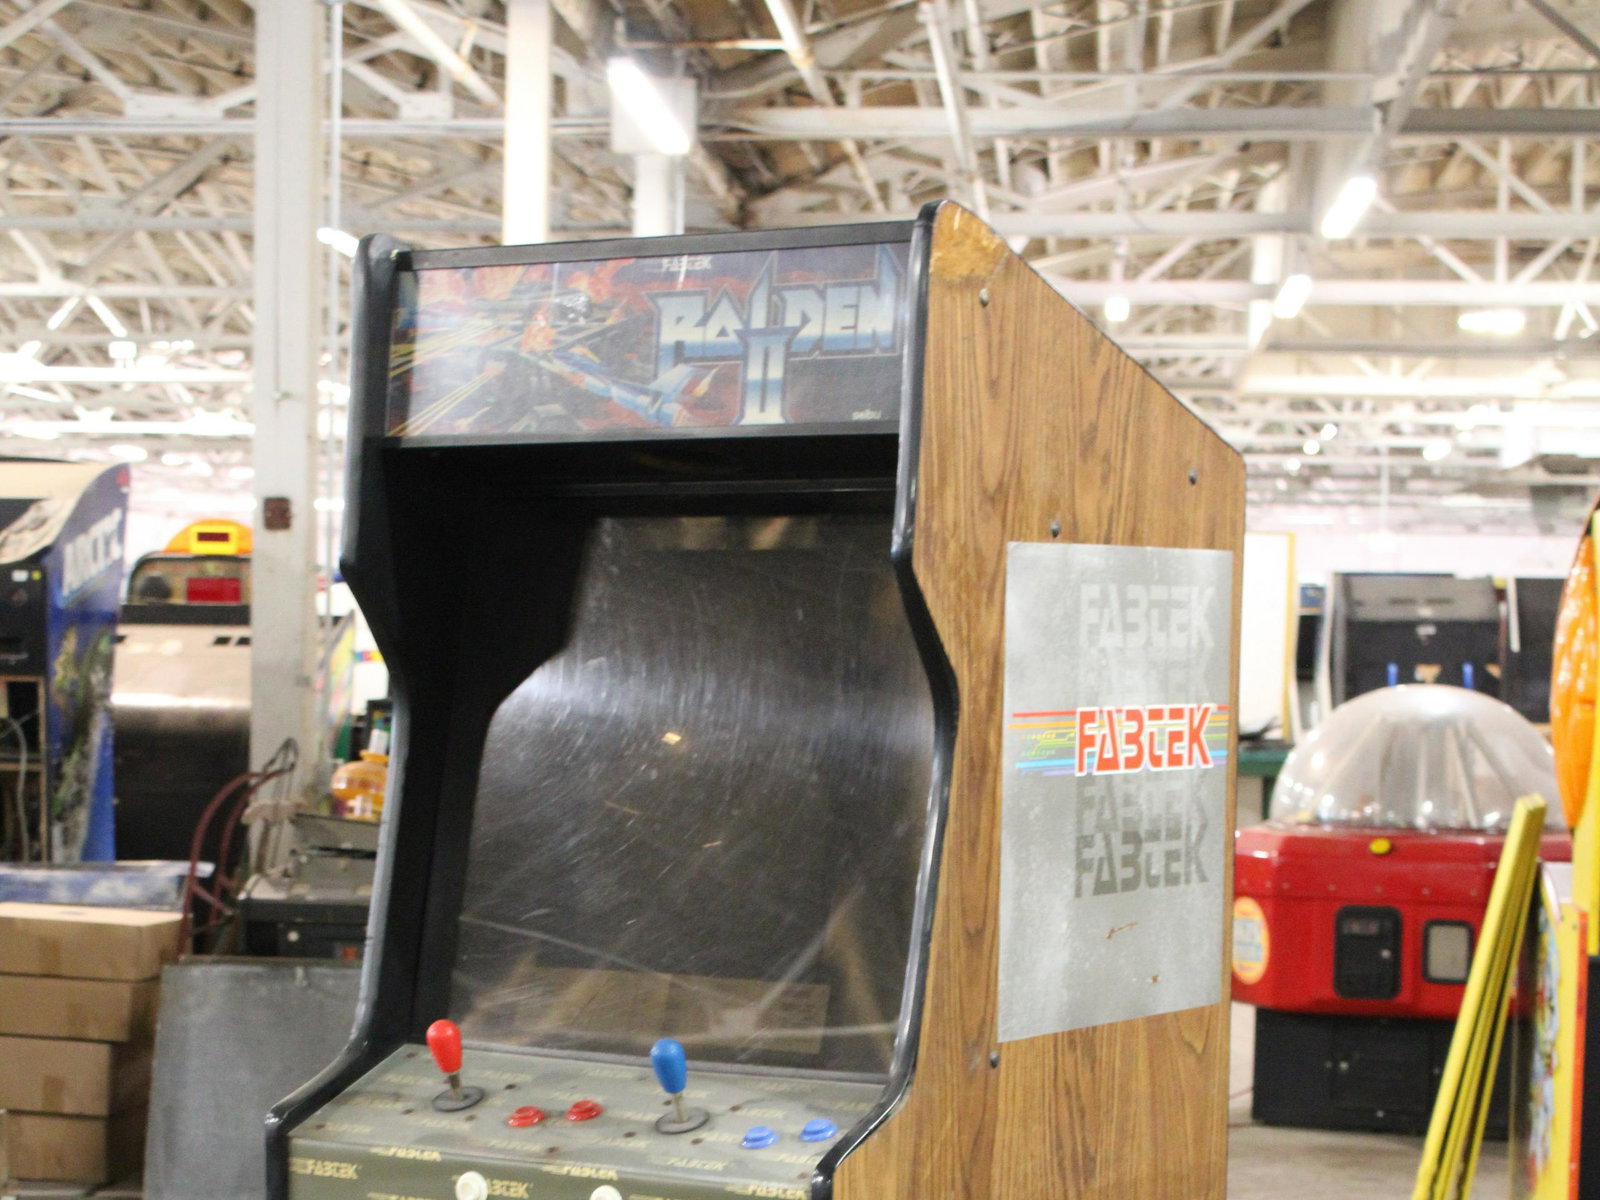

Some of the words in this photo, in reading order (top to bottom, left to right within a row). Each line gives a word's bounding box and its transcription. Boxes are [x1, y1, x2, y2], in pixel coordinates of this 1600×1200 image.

[648, 244, 898, 377] RAIDEN
[737, 326, 800, 425] II
[1079, 583, 1215, 648] FABTEK
[1075, 703, 1216, 777] FABTEK
[1073, 828, 1209, 899] FABTEK
